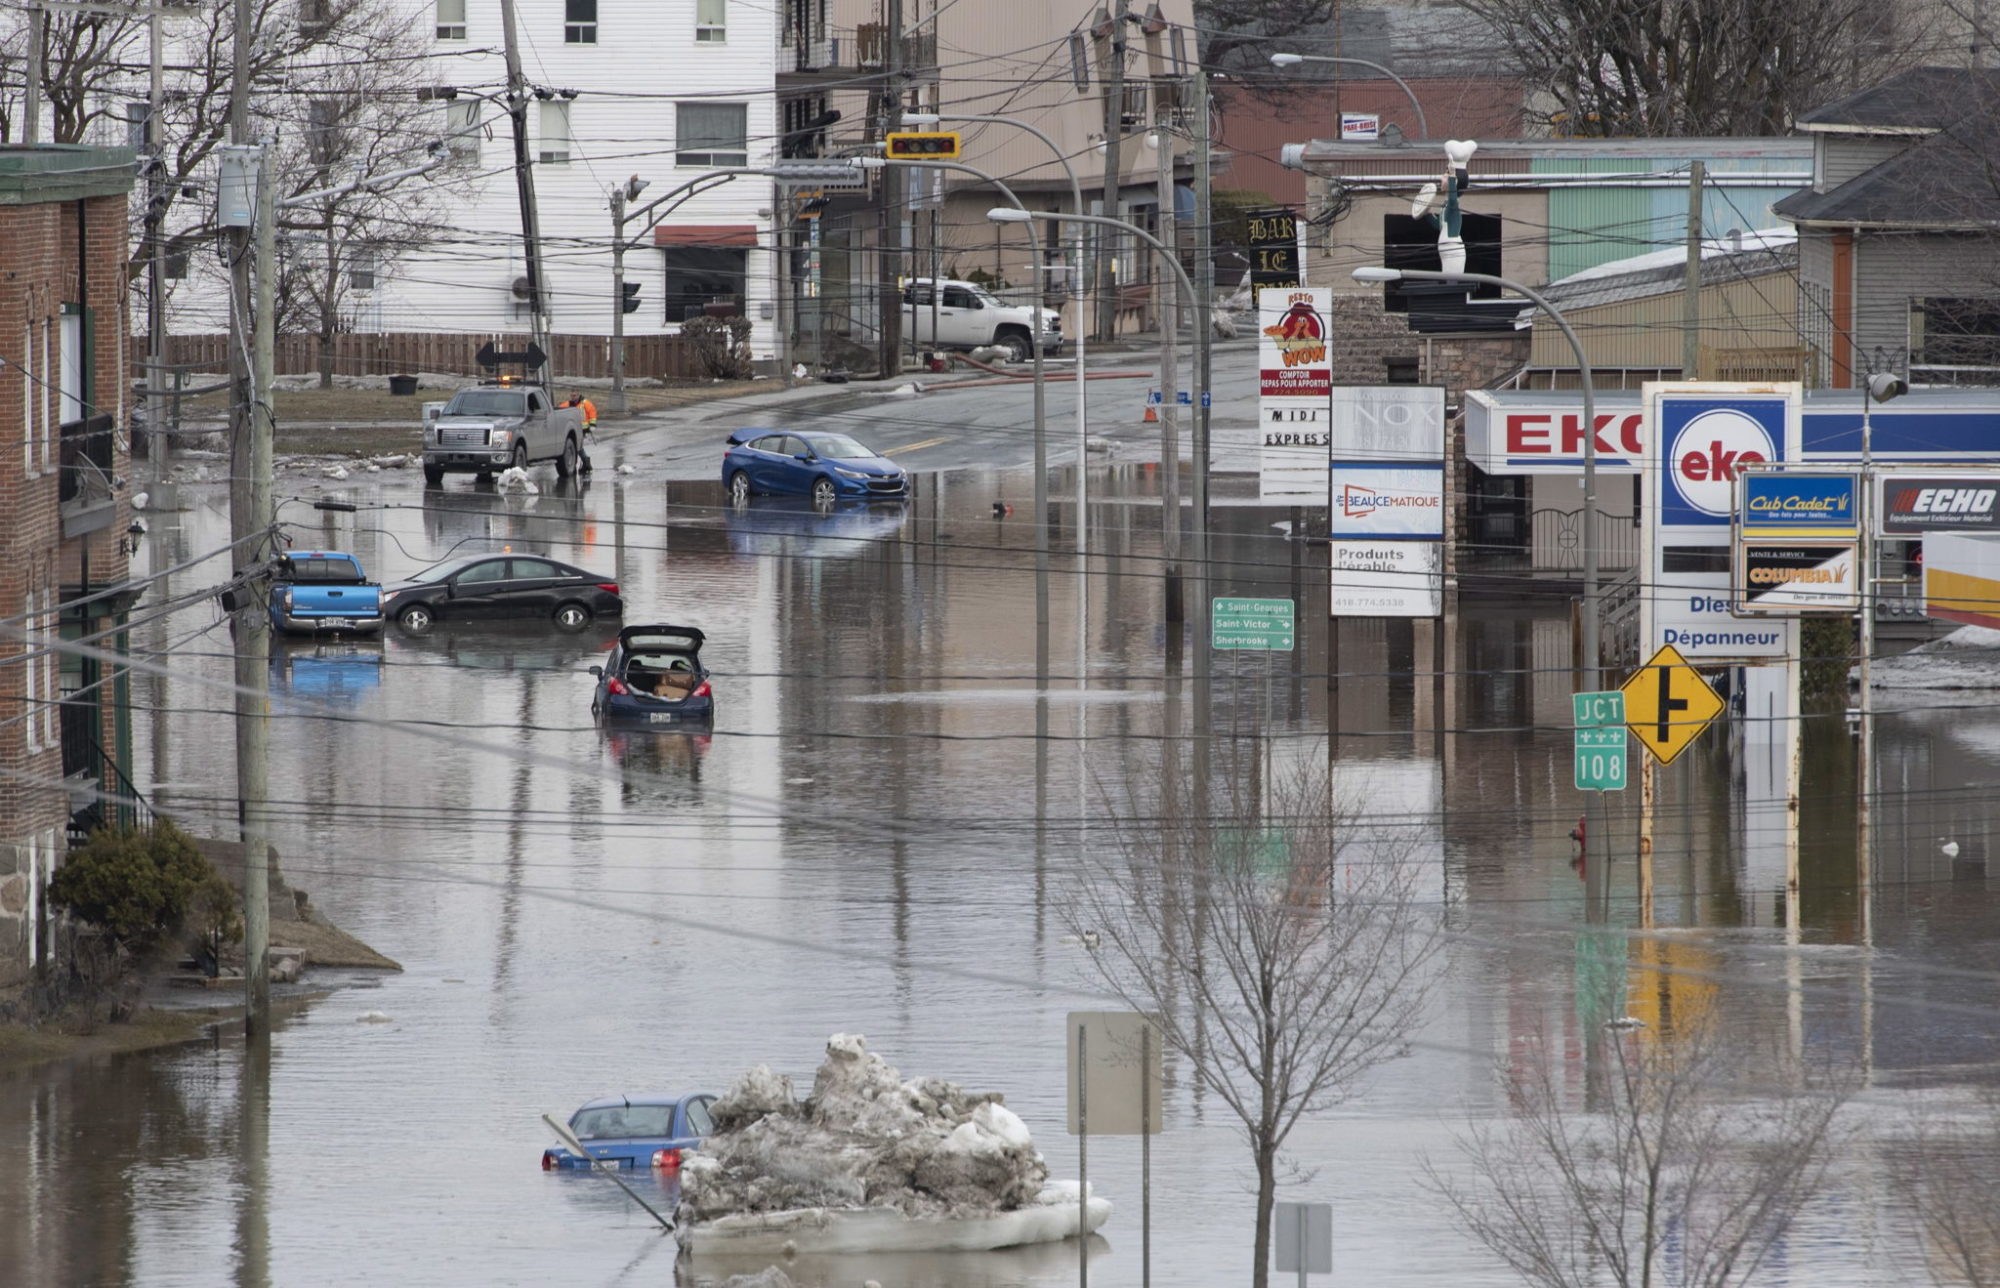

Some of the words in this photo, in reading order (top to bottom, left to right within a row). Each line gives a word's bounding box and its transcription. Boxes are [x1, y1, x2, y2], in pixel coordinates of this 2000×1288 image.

[1248, 217, 1295, 244] BAR
[1259, 250, 1288, 272] LE
[1288, 292, 1314, 306] RESTO
[1281, 344, 1327, 368] WOW
[1278, 370, 1310, 379] COMPTOIR
[1261, 379, 1280, 388] REPAS
[1280, 379, 1298, 388] POUR
[1298, 379, 1329, 388] APPORTER
[1271, 410, 1316, 422] MIDI
[1265, 433, 1329, 446] EXPRESS
[1348, 495, 1440, 507] BEAUCEMATIQUE
[1749, 496, 1781, 511] Cub
[1783, 495, 1837, 511] Cadet
[1912, 488, 1997, 513] ECHO
[1338, 548, 1404, 560] Produits
[1749, 567, 1833, 584] COLUMBIA
[1215, 620, 1272, 629] Saint-Victor
[1215, 636, 1268, 645] Sherbrooke
[1663, 628, 1779, 649] Dépanneur
[1580, 698, 1620, 720] JCT
[1580, 755, 1621, 780] 108
